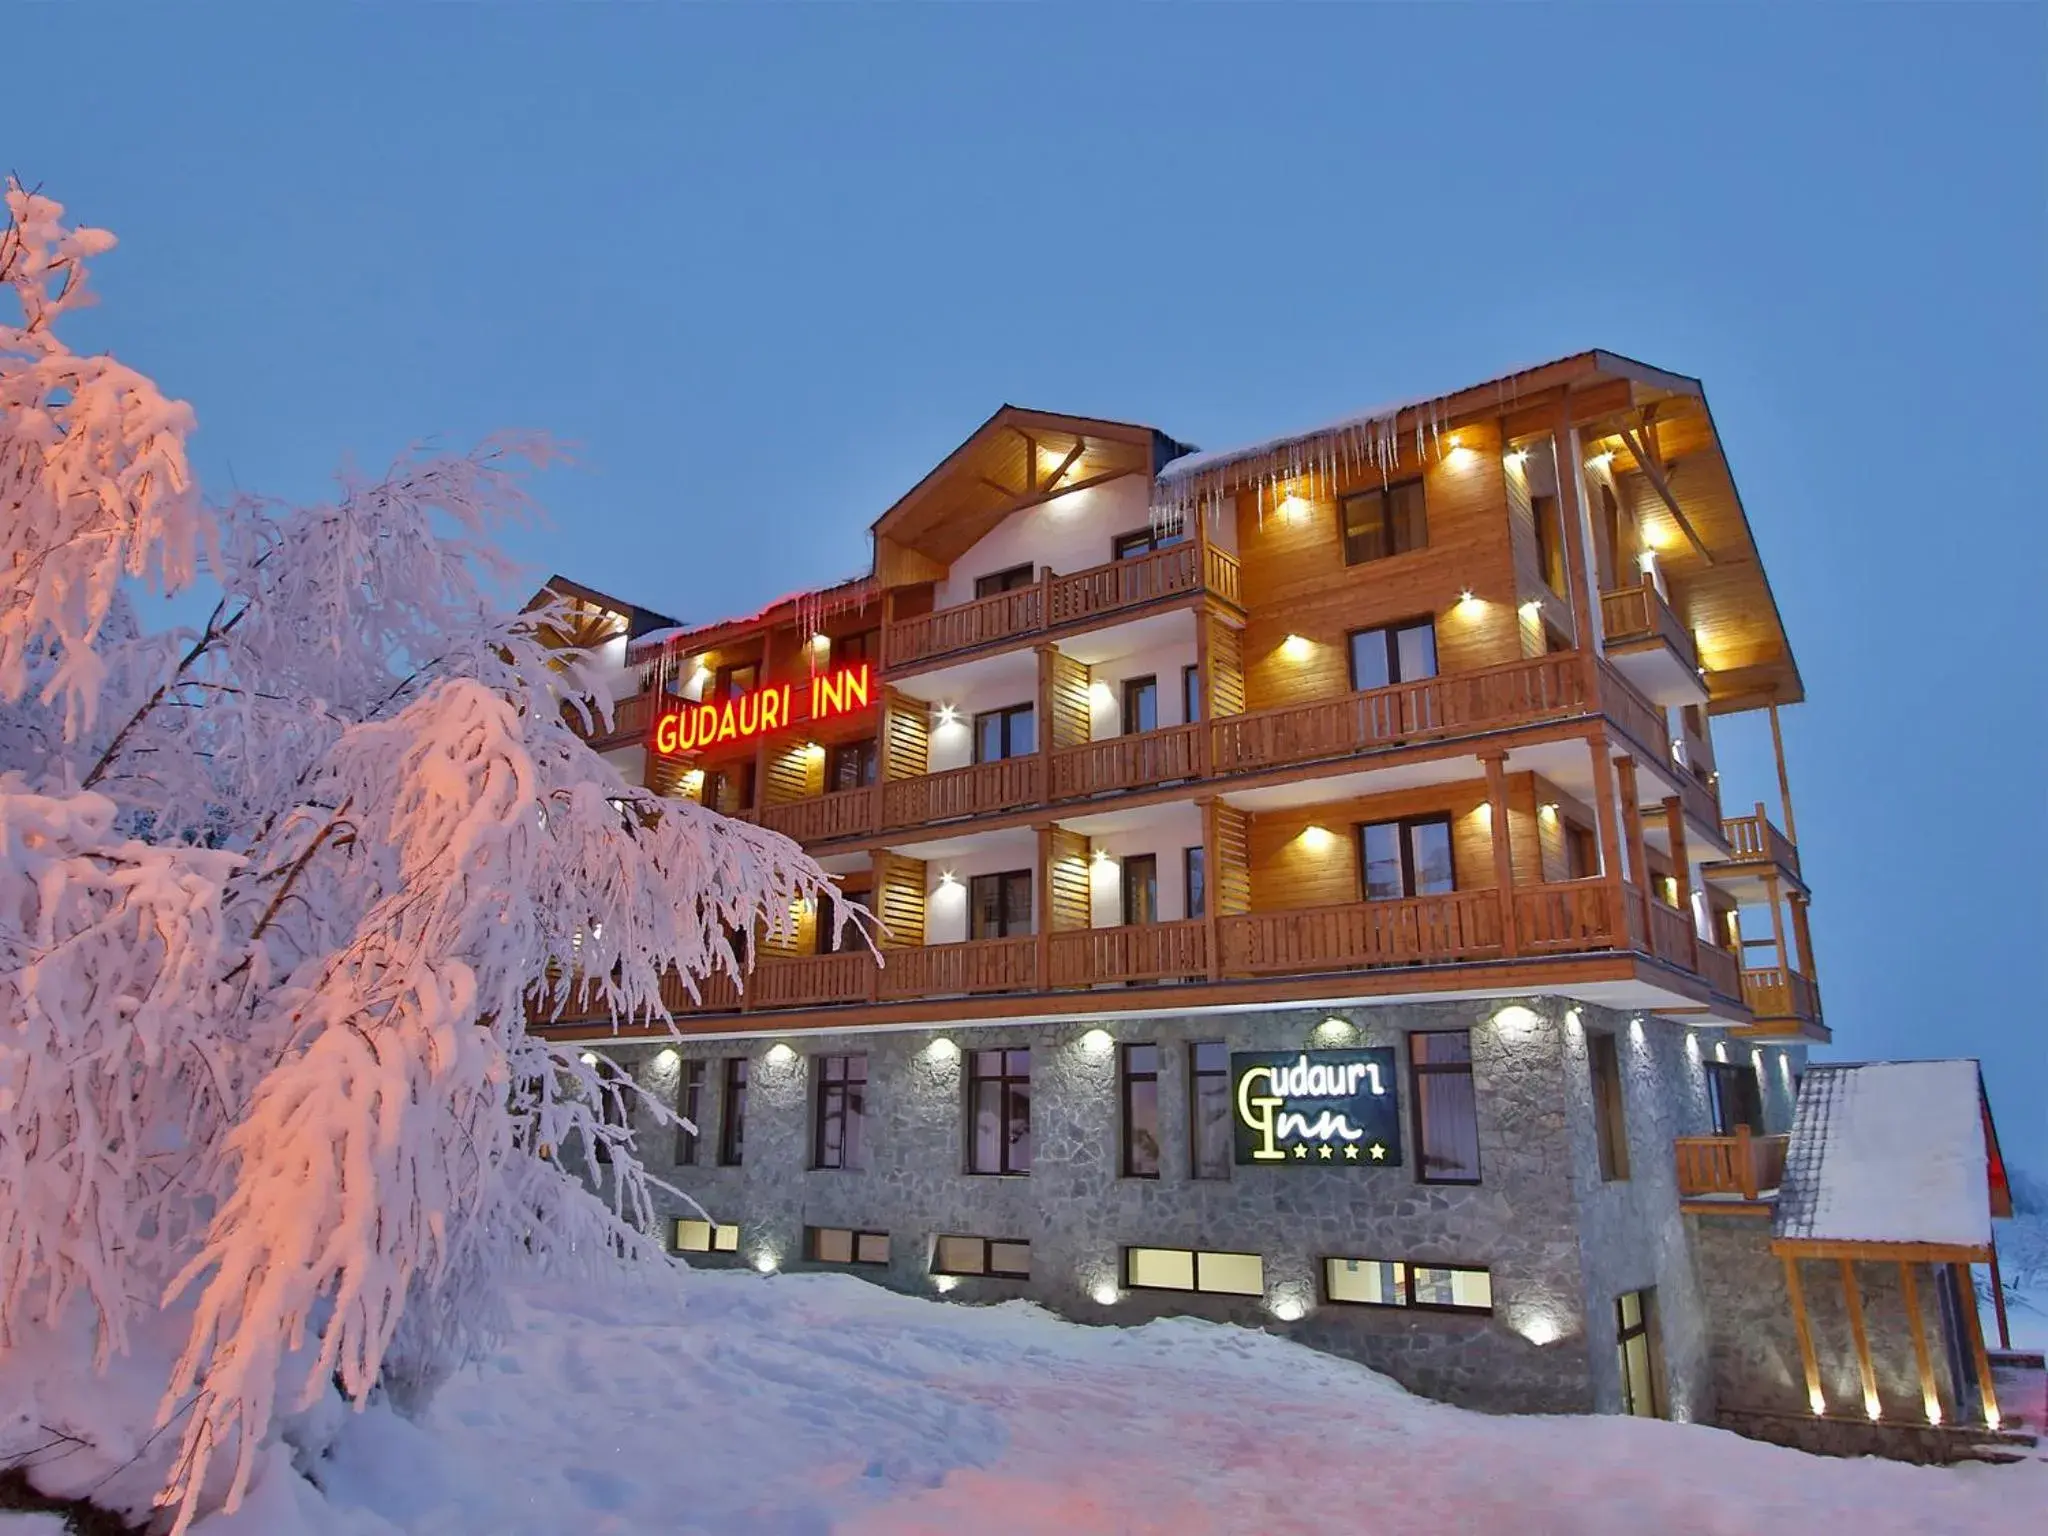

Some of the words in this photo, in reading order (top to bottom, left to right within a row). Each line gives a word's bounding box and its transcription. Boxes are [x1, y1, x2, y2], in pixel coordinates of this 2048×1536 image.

[657, 684, 790, 754] GUDAURI
[812, 664, 868, 720] INN
[1238, 1055, 1385, 1131] Gudauri
[1251, 1098, 1363, 1159] Inn
